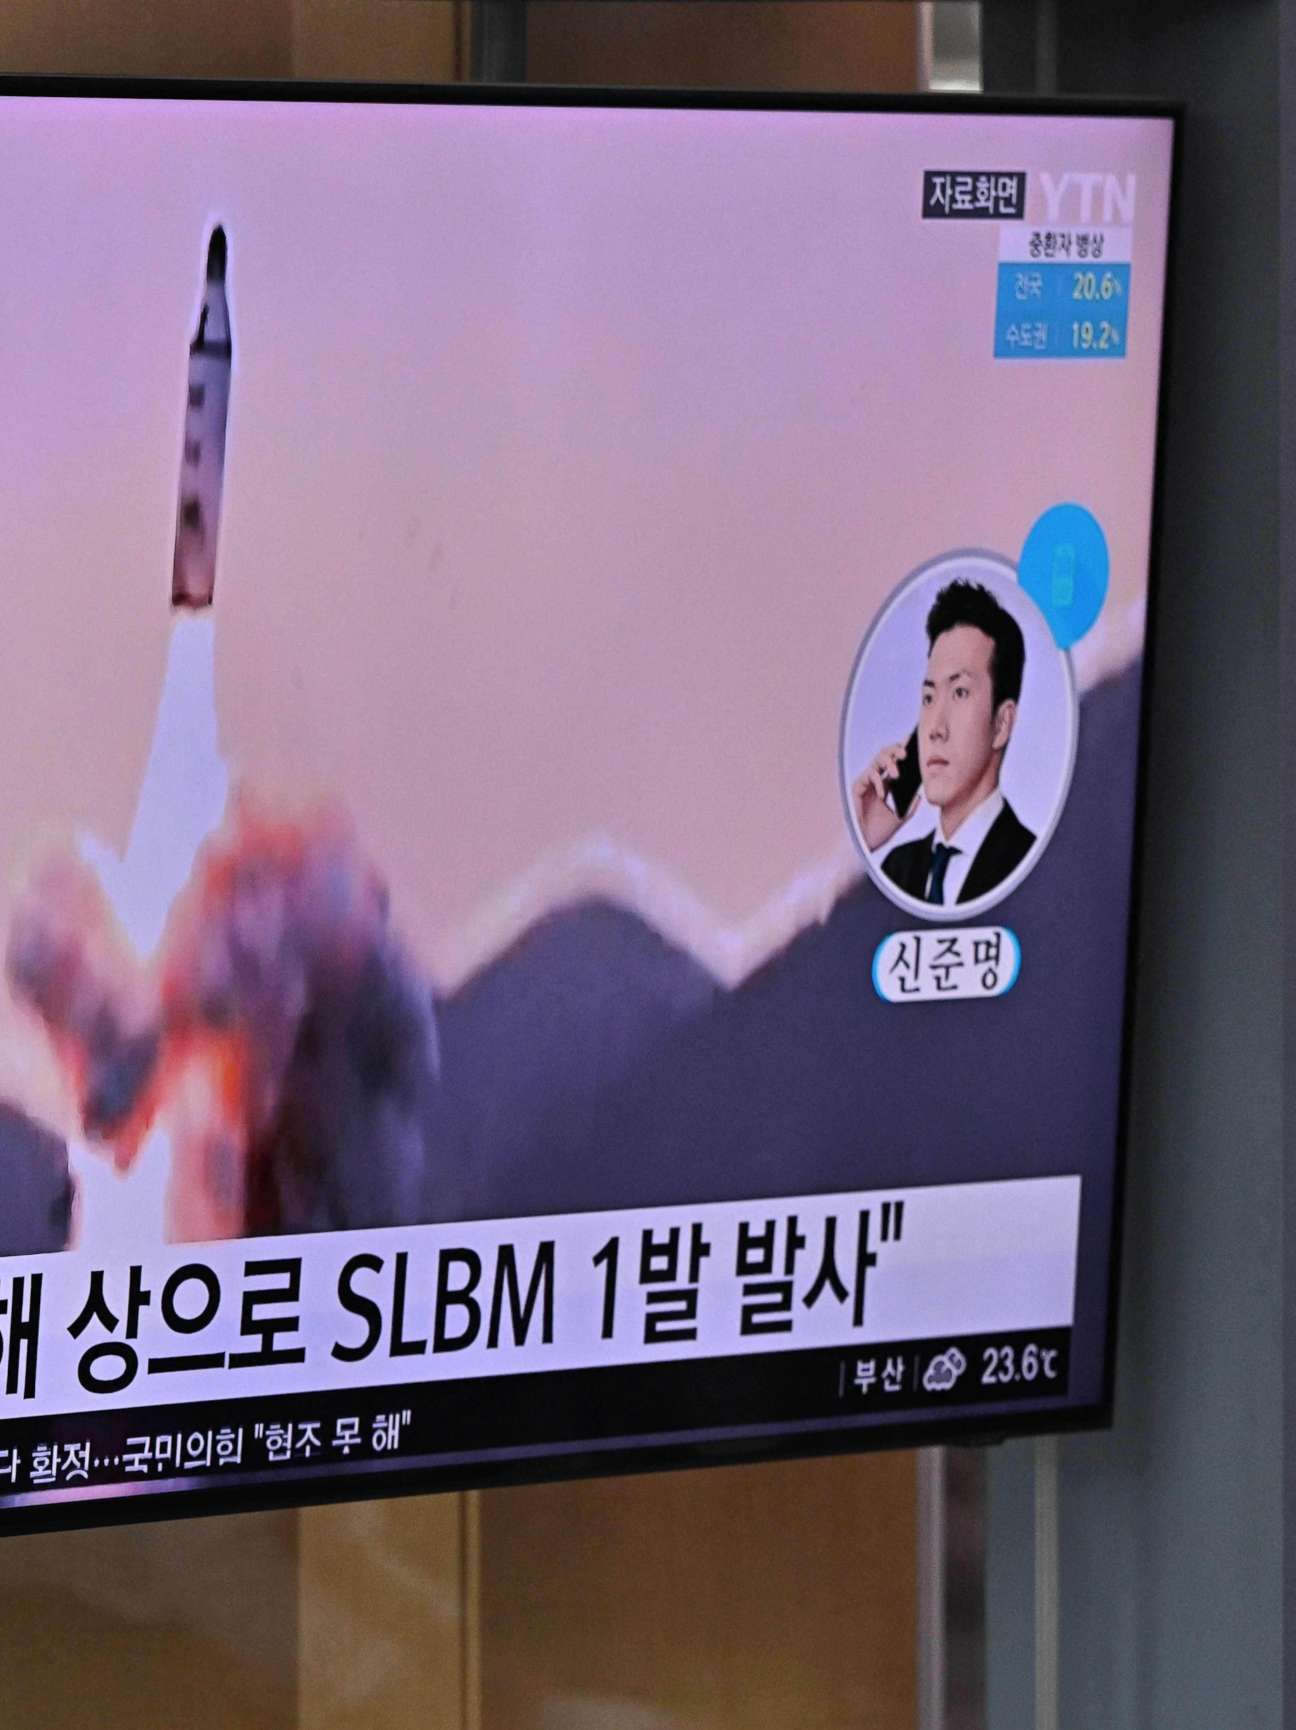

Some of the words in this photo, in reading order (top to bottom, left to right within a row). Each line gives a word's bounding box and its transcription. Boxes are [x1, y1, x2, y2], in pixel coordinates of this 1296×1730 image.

[929, 174, 1019, 215] 자료화면
[1039, 173, 1137, 223] YTN
[1029, 231, 1072, 258] 중환자
[1076, 232, 1105, 259] 병상
[889, 931, 1003, 994] 신준명
[67, 1256, 305, 1395] 상으로
[331, 1240, 555, 1363] SLBM
[592, 1222, 711, 1345] 1발
[735, 1200, 905, 1337] 발사"
[854, 1356, 906, 1395] 부산
[372, 1410, 412, 1451] 해"
